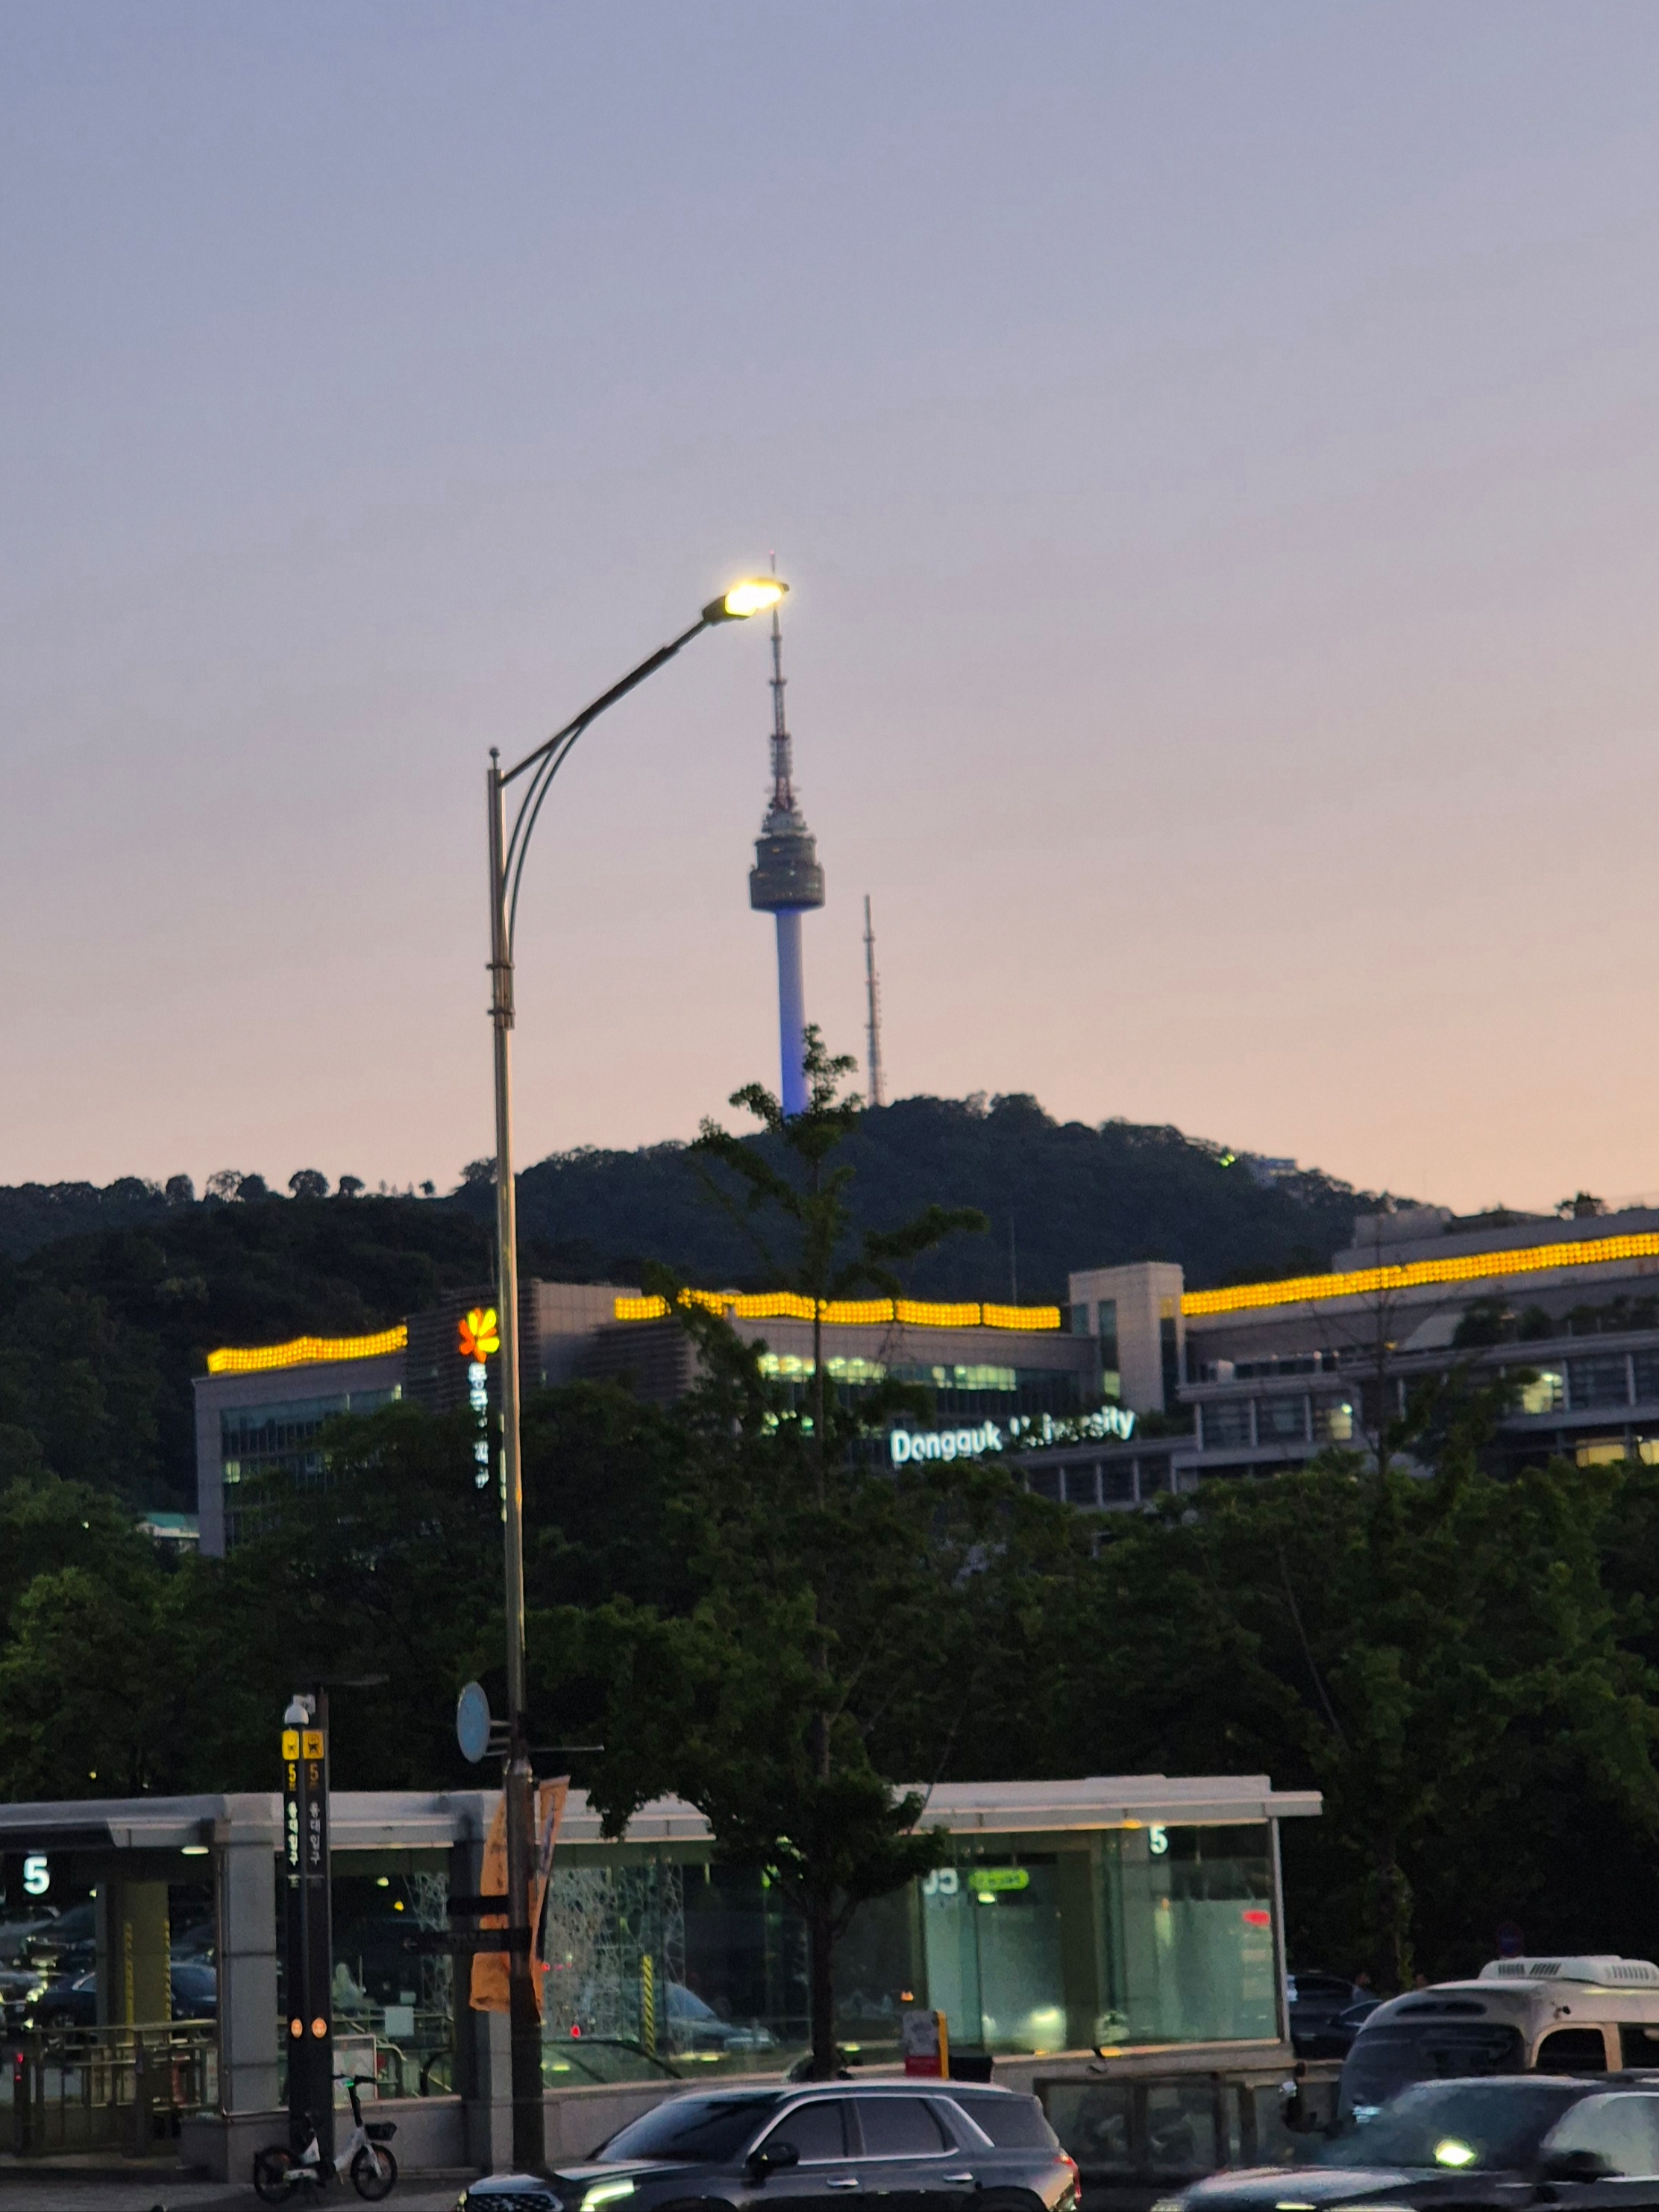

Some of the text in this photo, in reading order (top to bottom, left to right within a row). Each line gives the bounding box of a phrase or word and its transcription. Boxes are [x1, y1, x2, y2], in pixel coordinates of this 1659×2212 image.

[288, 1763, 296, 1782] 5
[310, 1763, 319, 1782] 5
[1150, 1825, 1167, 1854] 5
[23, 1856, 50, 1895] 5
